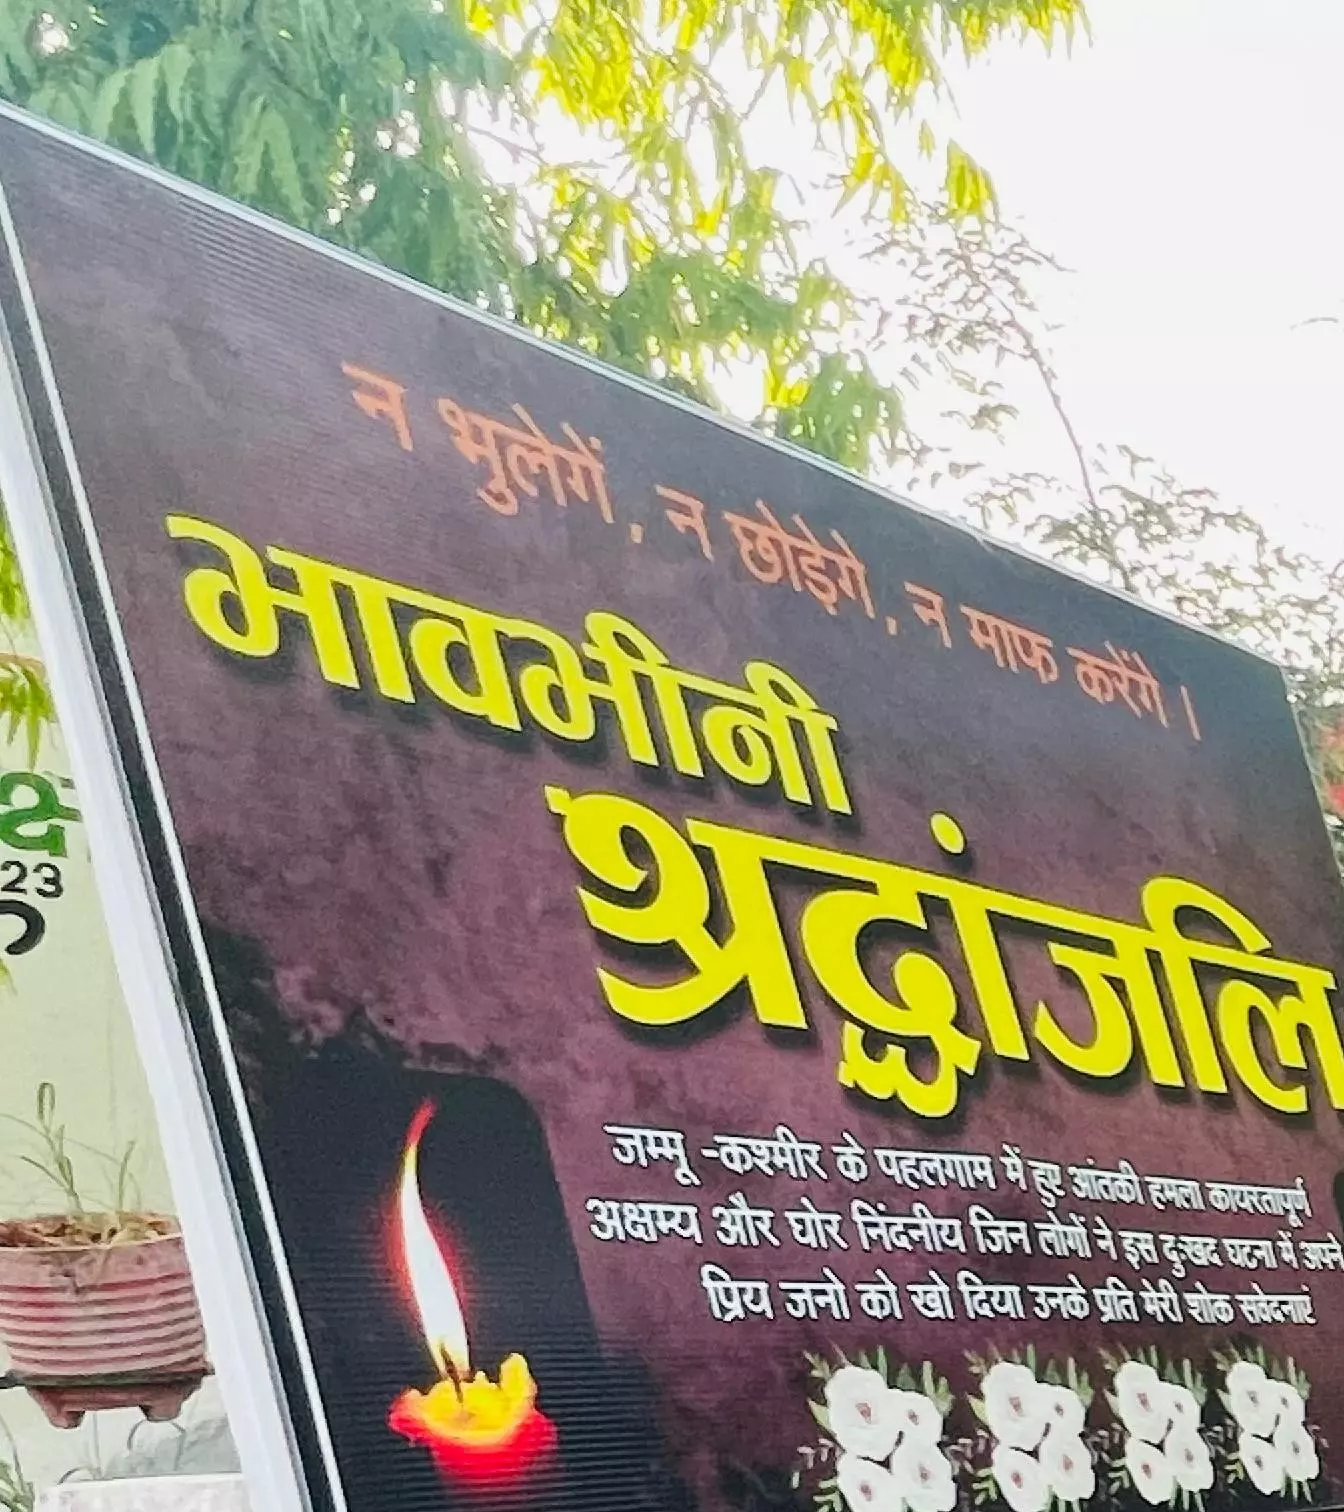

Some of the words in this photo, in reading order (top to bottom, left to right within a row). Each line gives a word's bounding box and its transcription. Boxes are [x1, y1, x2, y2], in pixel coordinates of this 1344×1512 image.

[341, 361, 413, 451] न
[655, 484, 715, 563] न
[904, 581, 951, 648] न
[959, 605, 1058, 684] माफ
[166, 514, 854, 815] भावभीनी
[603, 1124, 701, 1186] जम्मू
[831, 1131, 869, 1183] के
[873, 1148, 996, 1190] पहलगाम
[1000, 1142, 1028, 1192] में
[1027, 1159, 1067, 1208] हुए
[1145, 1176, 1206, 1212] हमला
[1205, 1176, 1313, 1228] कायरतापूर्ण
[586, 1199, 703, 1244] अक्षम्य
[712, 1191, 781, 1247] और
[784, 1197, 849, 1250] घोर
[850, 1200, 967, 1253] निंदनीय
[968, 1205, 1032, 1254] जिन
[1033, 1210, 1092, 1258] लोगों
[1093, 1216, 1118, 1261] ने
[1118, 1230, 1160, 1270] इस
[1221, 1238, 1279, 1270] घटना
[1276, 1230, 1300, 1270] में
[700, 1264, 774, 1322] प्रिय
[854, 1268, 903, 1320] को
[906, 1270, 956, 1320] खो
[957, 1270, 1026, 1320] दिया
[1027, 1273, 1090, 1320] उनके
[1092, 1276, 1141, 1323] प्रति
[1139, 1278, 1185, 1323] मेरी
[1183, 1280, 1236, 1325] शोक
